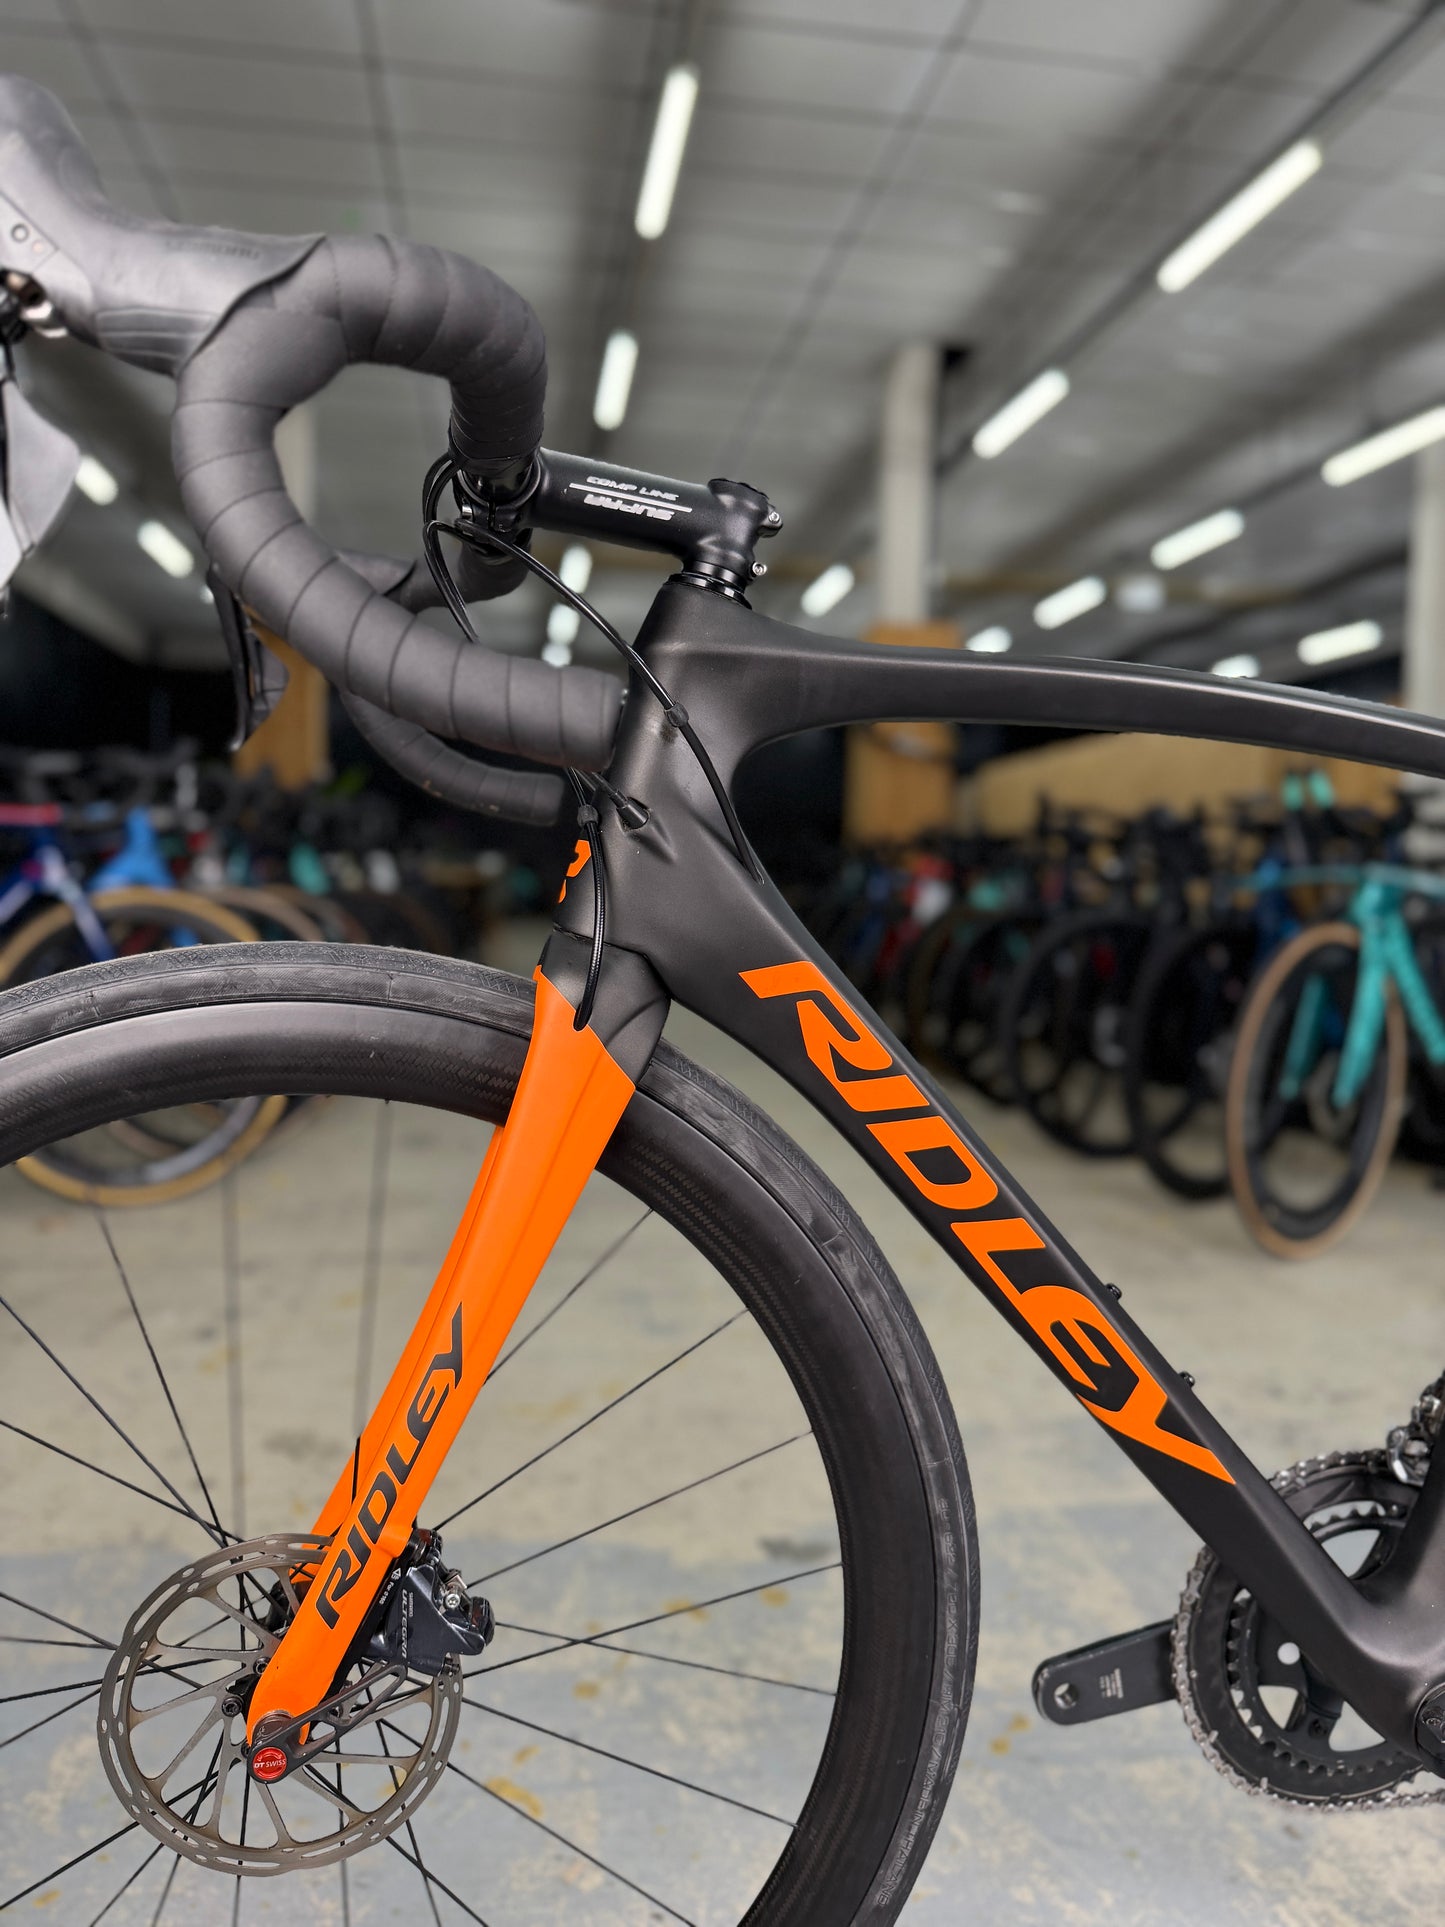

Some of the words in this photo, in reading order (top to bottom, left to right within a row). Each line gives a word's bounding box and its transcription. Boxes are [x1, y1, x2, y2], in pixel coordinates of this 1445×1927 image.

[586, 476, 638, 491] COMP
[639, 487, 680, 501] LINE
[739, 961, 1236, 1485] RIDLEY
[315, 1301, 462, 1630] RIDLEY
[253, 1761, 265, 1769] DT
[265, 1758, 286, 1768] SWISS
